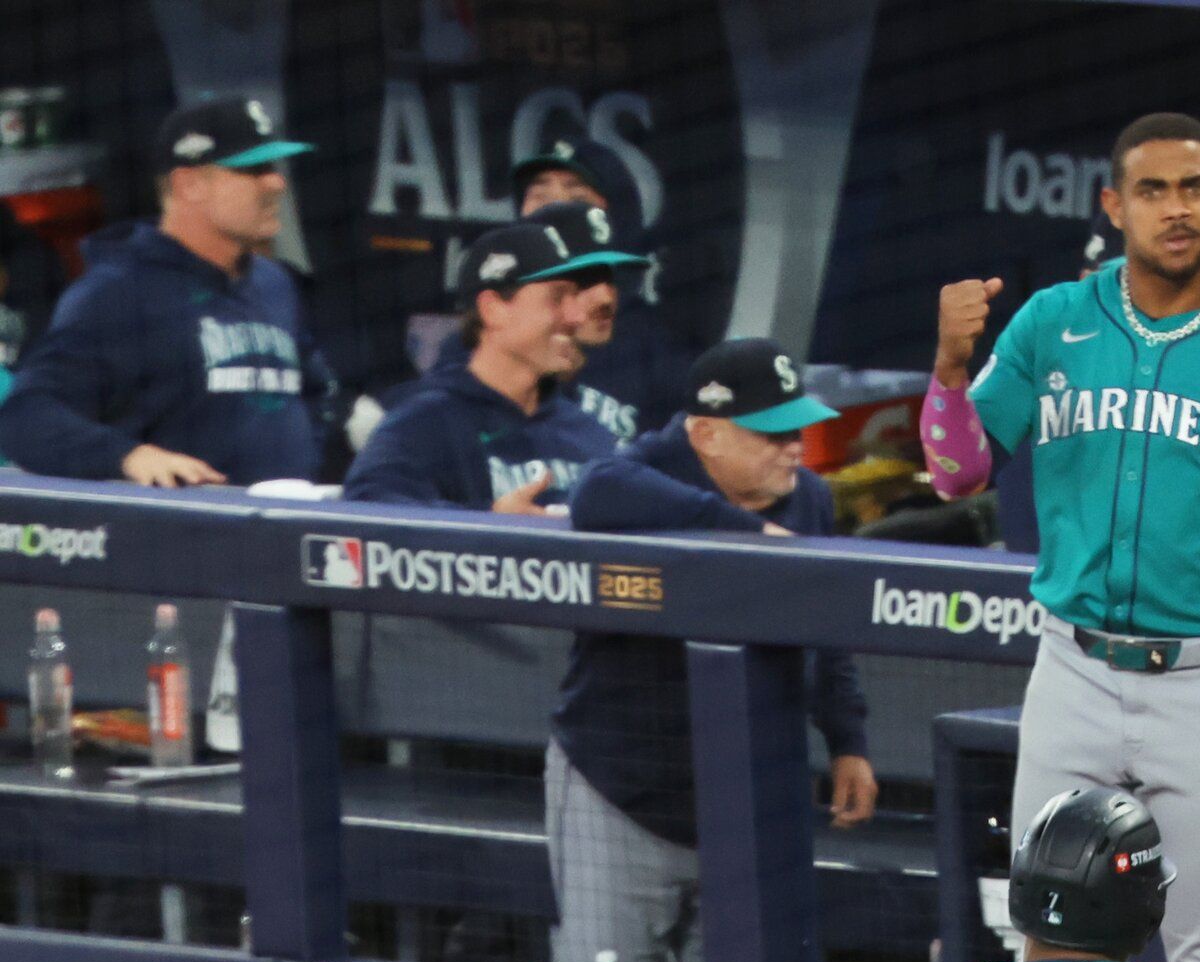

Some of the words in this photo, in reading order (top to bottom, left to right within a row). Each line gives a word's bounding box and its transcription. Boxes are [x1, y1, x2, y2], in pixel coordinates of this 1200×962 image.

[774, 354, 798, 393] S
[366, 541, 591, 605] POSTSEASON
[598, 574, 664, 601] 2025
[872, 578, 1048, 645] loanDepo
